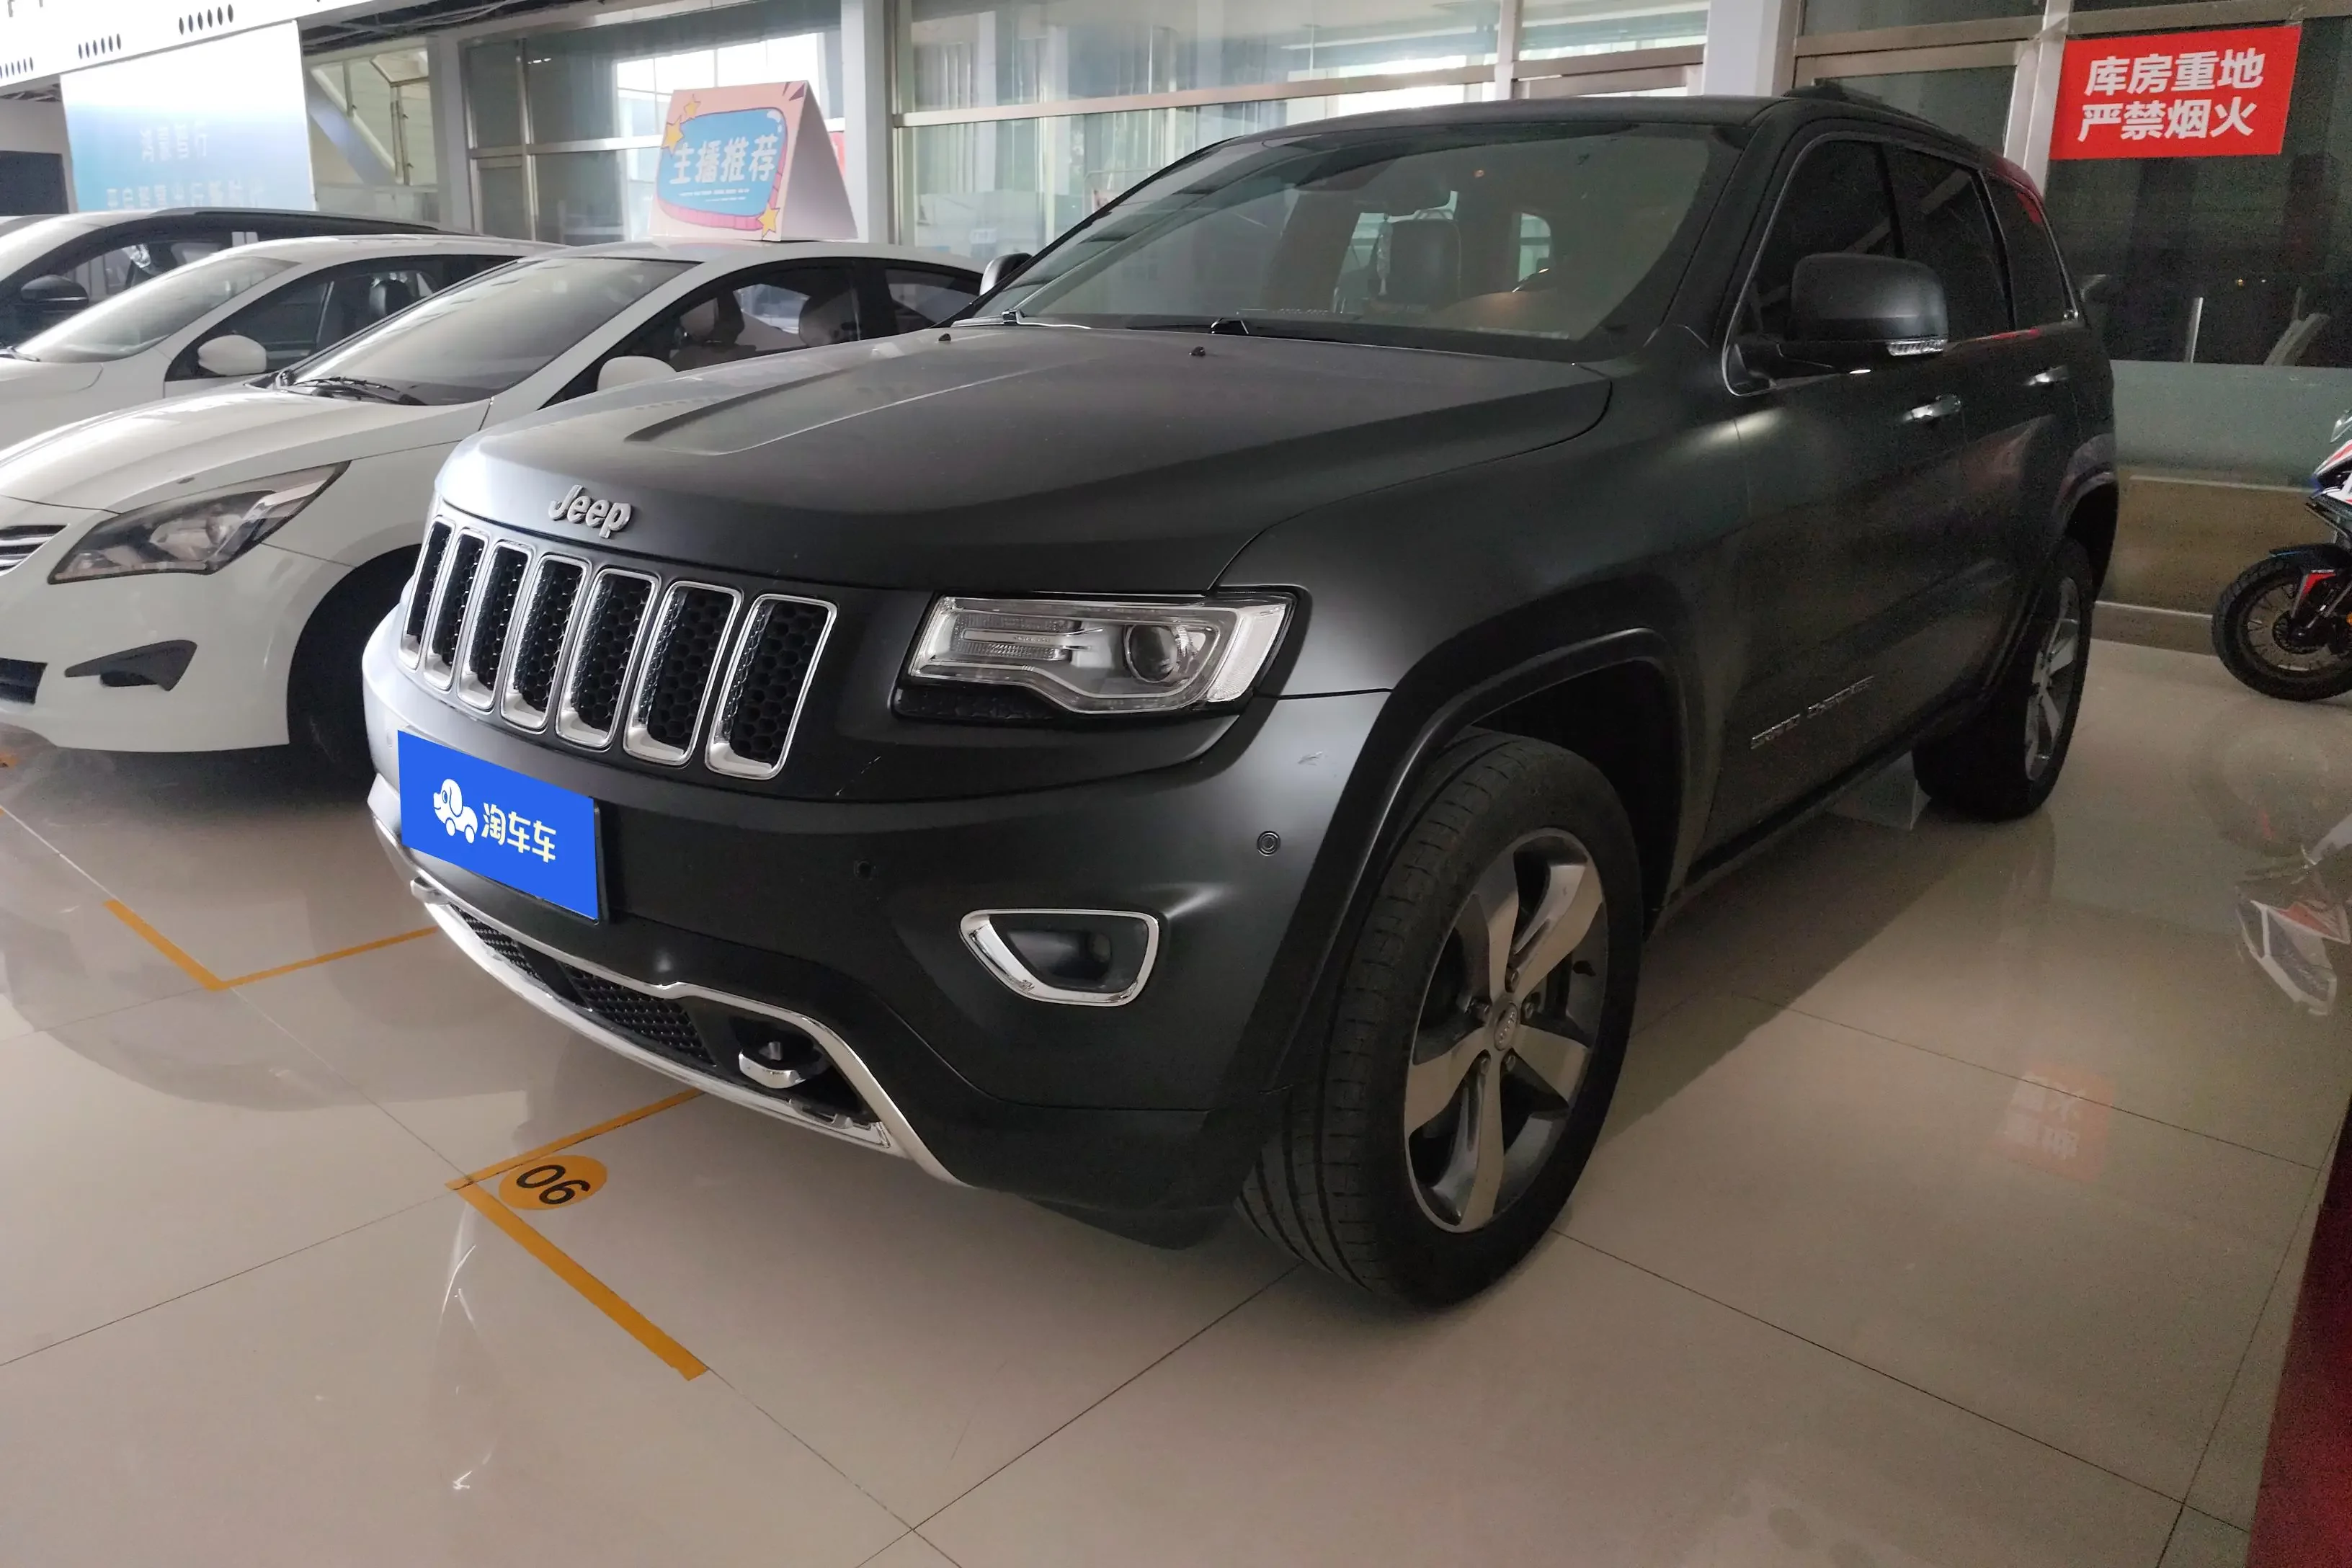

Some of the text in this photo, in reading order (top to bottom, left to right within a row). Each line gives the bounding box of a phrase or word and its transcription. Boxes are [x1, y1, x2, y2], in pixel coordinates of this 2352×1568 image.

[2084, 48, 2266, 96] 库房重地
[2077, 97, 2257, 142] 严禁烟火
[669, 133, 779, 184] 主播推荐
[548, 484, 631, 539] Jeep
